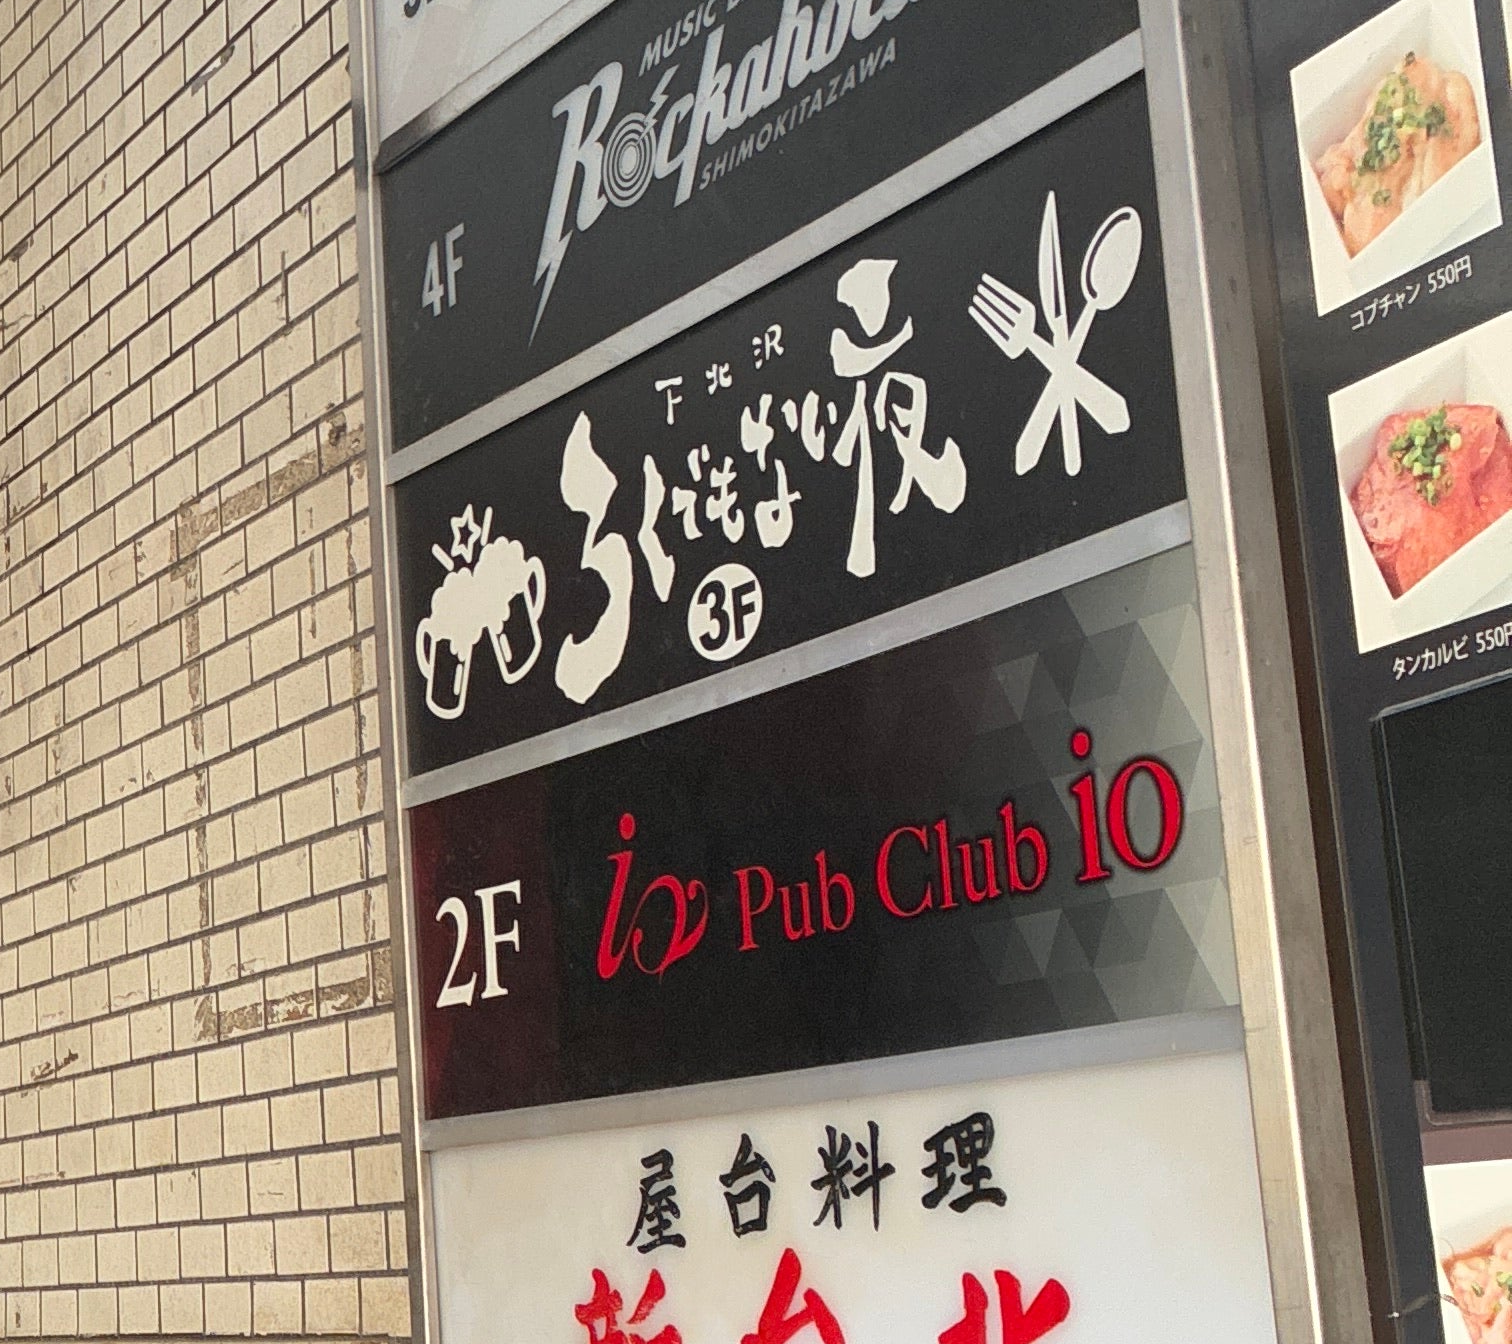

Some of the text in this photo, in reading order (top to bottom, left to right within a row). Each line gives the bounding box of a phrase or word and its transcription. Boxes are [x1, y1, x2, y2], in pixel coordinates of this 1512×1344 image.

[699, 38, 897, 190] SHIMOKITAZAWA
[421, 223, 465, 318] 4F
[1427, 255, 1473, 294] 550円
[655, 323, 785, 425] 下北沢
[697, 578, 758, 652] 3F
[1393, 635, 1469, 680] タンカルビ
[435, 880, 522, 1008] 2F
[733, 851, 854, 952] Pub
[877, 802, 1049, 918] Club
[1072, 728, 1183, 884] io
[626, 1111, 1006, 1254] 屋台料理
